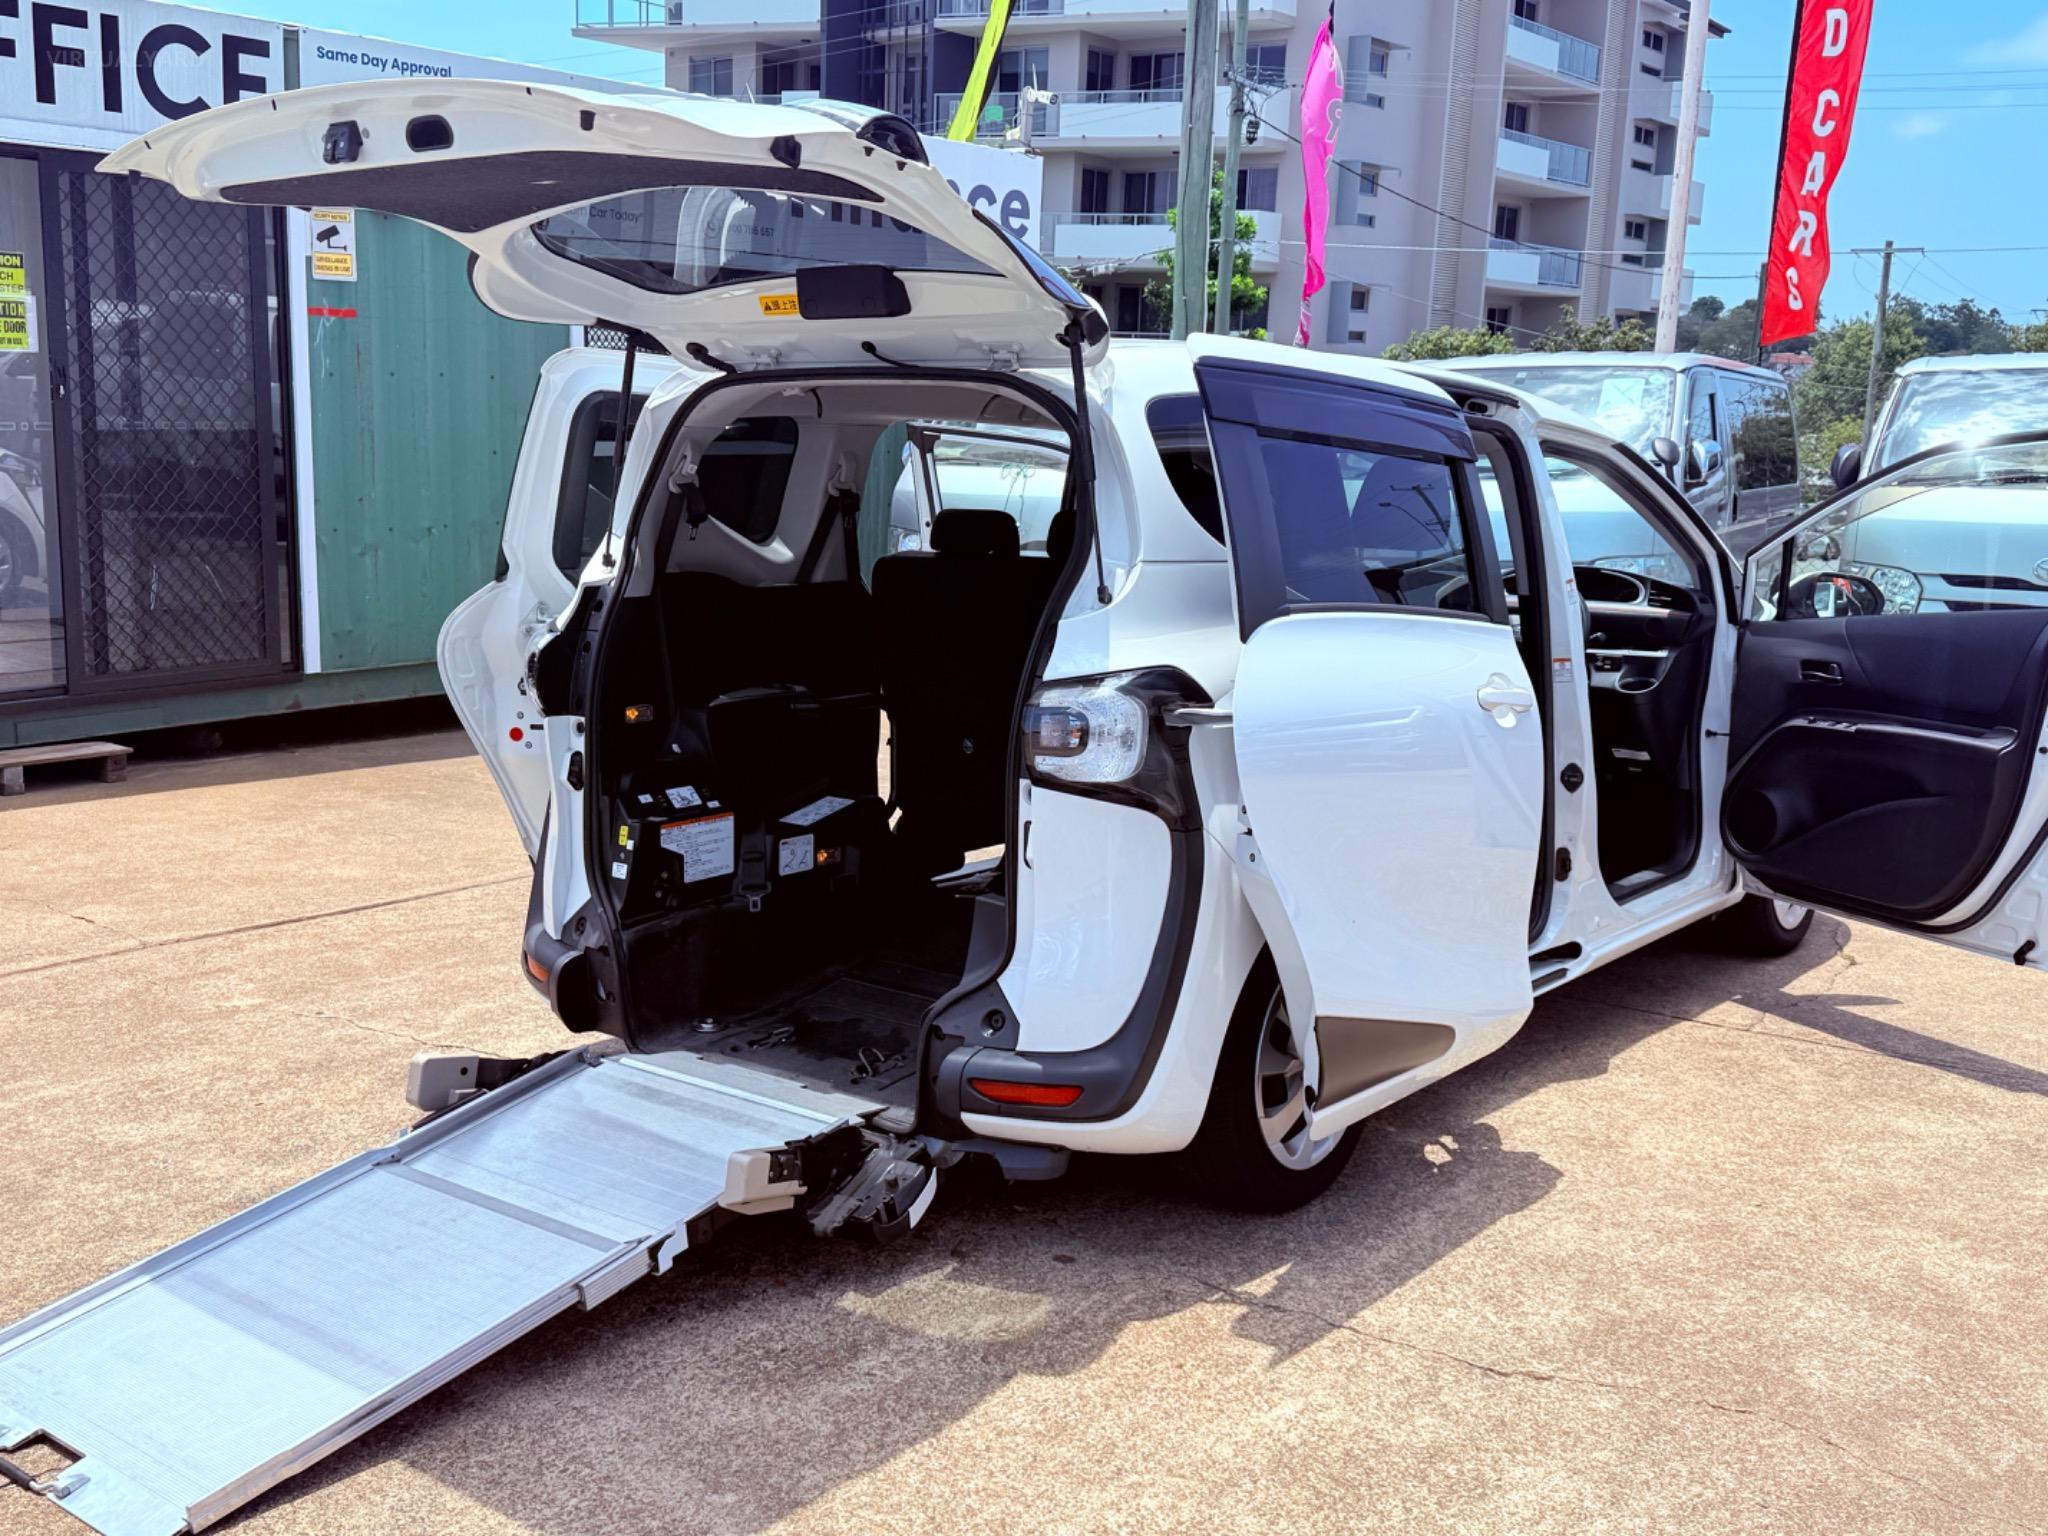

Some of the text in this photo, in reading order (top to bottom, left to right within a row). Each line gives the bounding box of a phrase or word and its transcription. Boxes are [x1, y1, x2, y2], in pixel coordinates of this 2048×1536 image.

[316, 45, 452, 77] Same Day Approval
[590, 206, 607, 218] Car
[1785, 88, 1840, 311] CARS
